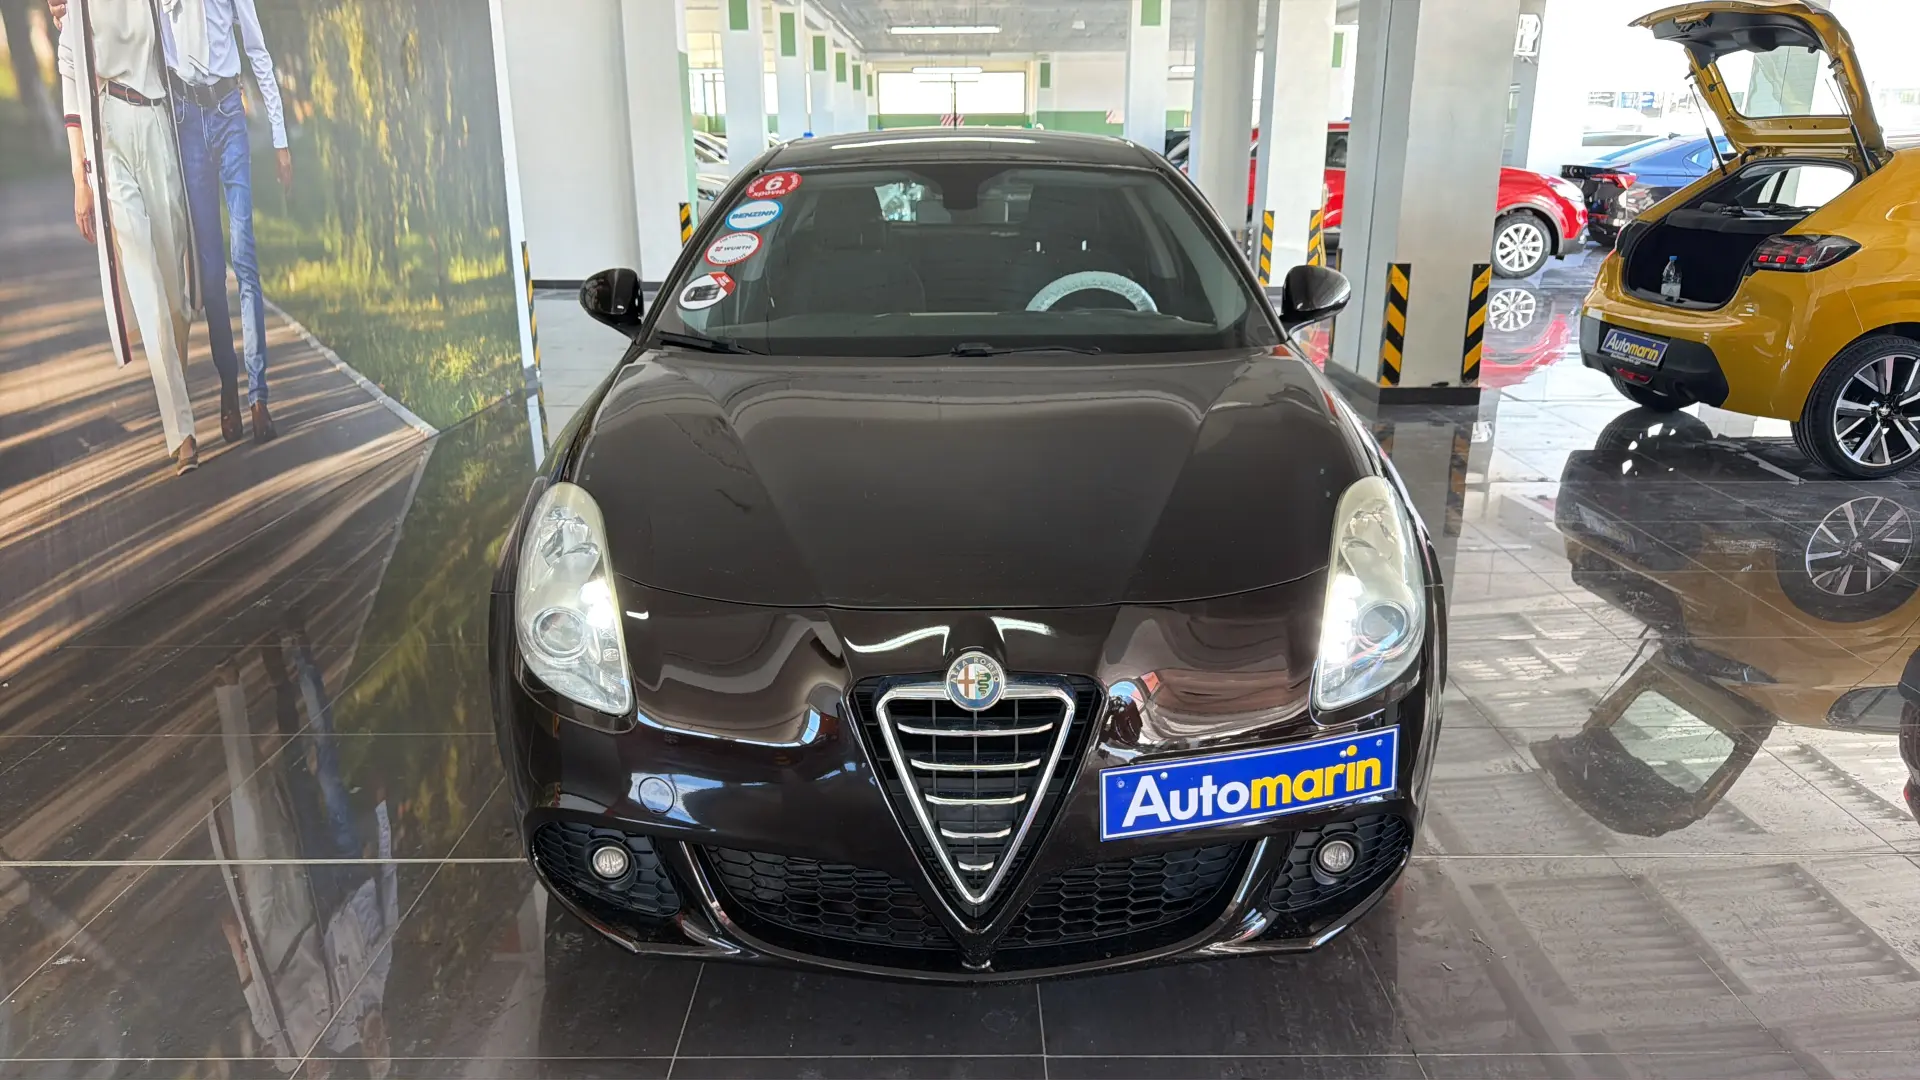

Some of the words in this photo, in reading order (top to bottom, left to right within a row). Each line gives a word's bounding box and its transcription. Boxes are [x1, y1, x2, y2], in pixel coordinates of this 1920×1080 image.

[764, 175, 785, 191] 6
[731, 209, 777, 220] BENZINN
[1605, 332, 1659, 361] Automarin
[950, 660, 968, 684] ALFA
[973, 656, 1000, 683] ROMEO
[1121, 744, 1381, 828] Automarin
